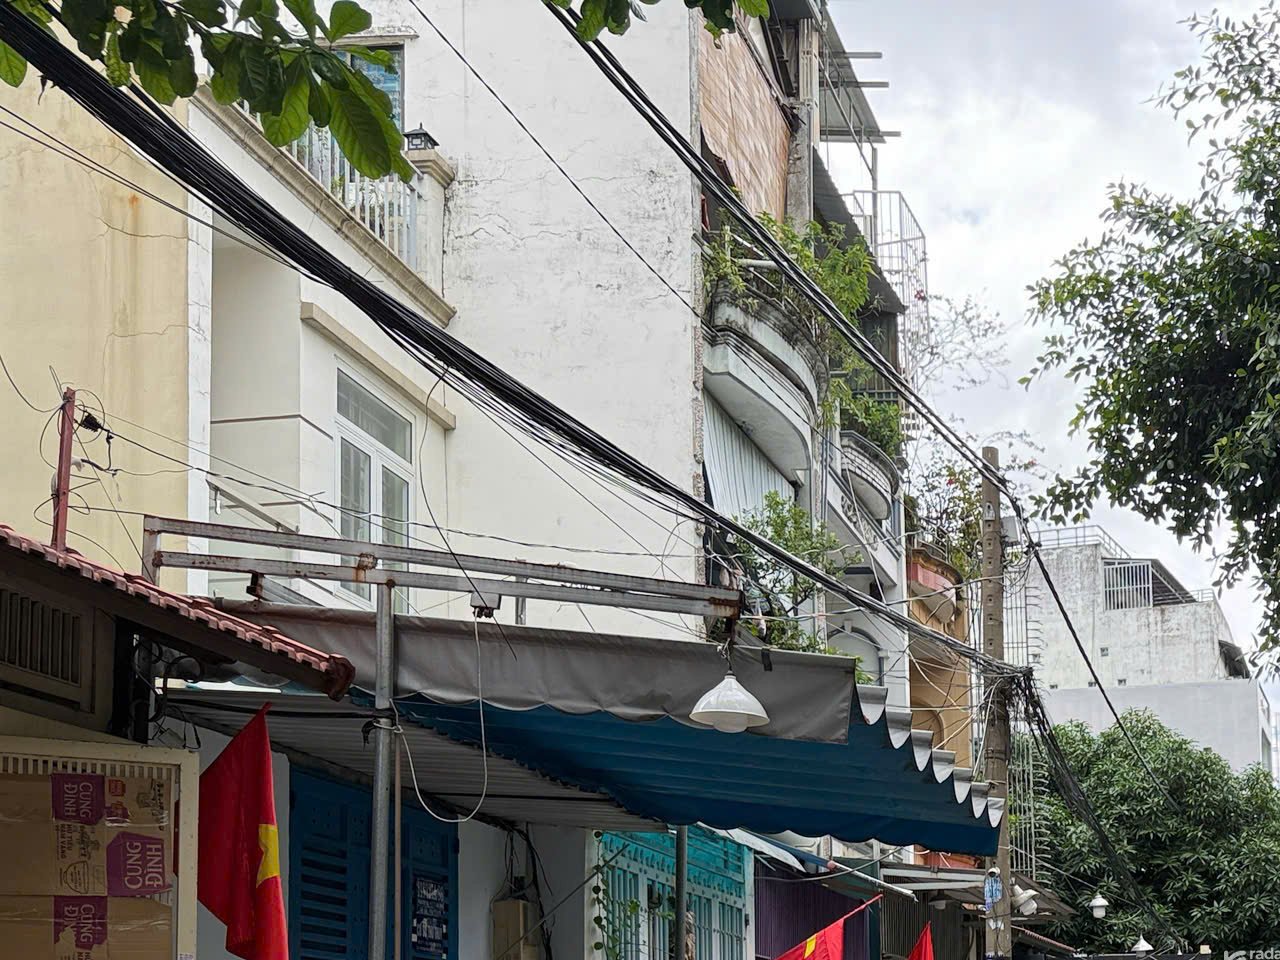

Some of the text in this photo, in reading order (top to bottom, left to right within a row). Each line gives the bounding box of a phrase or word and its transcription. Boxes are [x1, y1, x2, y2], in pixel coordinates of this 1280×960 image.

[79, 782, 93, 818] CUNG
[124, 842, 143, 889] CUNG
[144, 844, 163, 888] ĐÌNH
[64, 905, 80, 934] ĐÌN
[80, 904, 95, 942] CUNG
